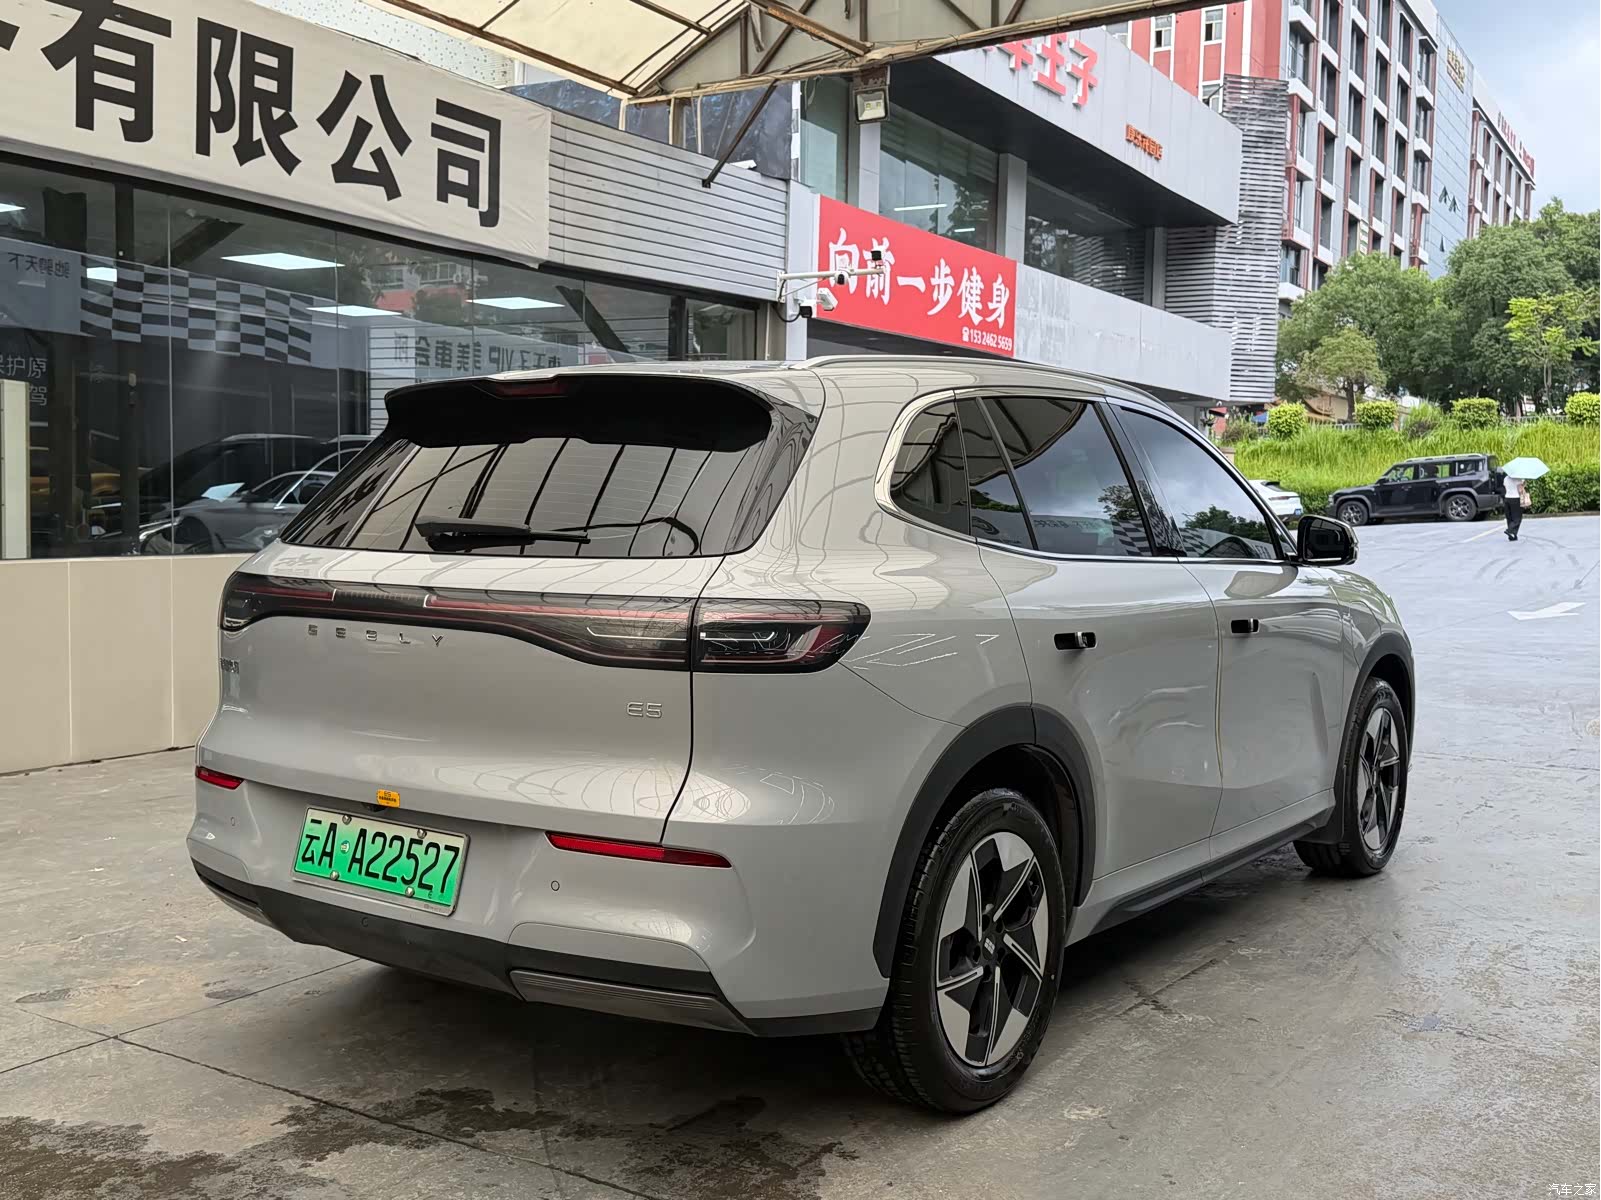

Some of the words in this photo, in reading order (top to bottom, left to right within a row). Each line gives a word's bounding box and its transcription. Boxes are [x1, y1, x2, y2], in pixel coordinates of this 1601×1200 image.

[0, 0, 502, 228] 有限公司
[827, 226, 1010, 330] 向前一步健身
[626, 700, 663, 719] E5
[301, 818, 338, 869] 云A
[347, 827, 461, 894] A22527
